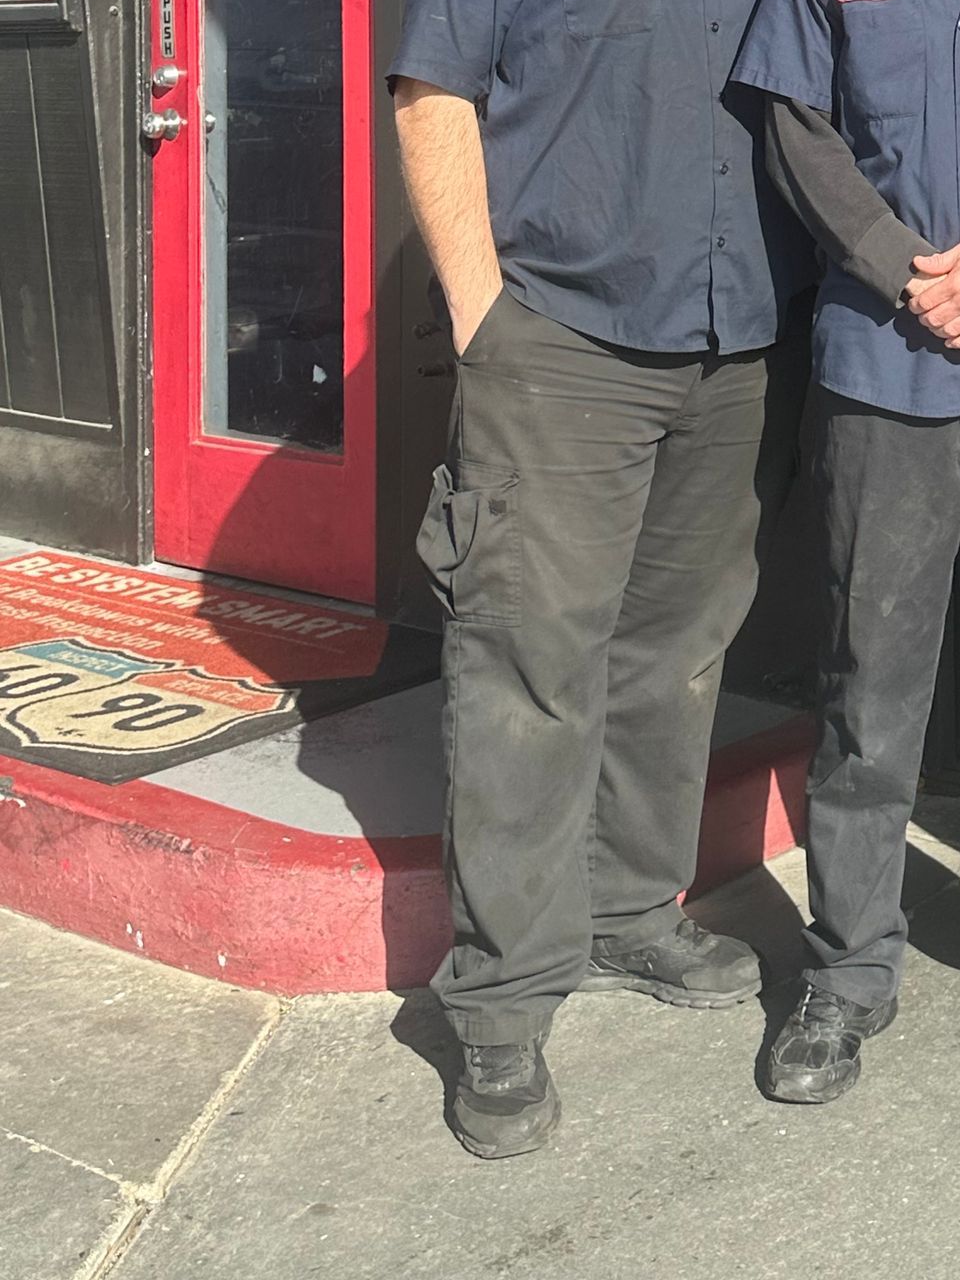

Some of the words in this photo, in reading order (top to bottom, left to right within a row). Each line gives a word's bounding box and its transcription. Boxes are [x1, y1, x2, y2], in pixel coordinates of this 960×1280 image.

[0, 556, 75, 577] BE
[50, 569, 219, 609] SYSTEM
[200, 600, 367, 638] SMART
[66, 693, 206, 732] 90
